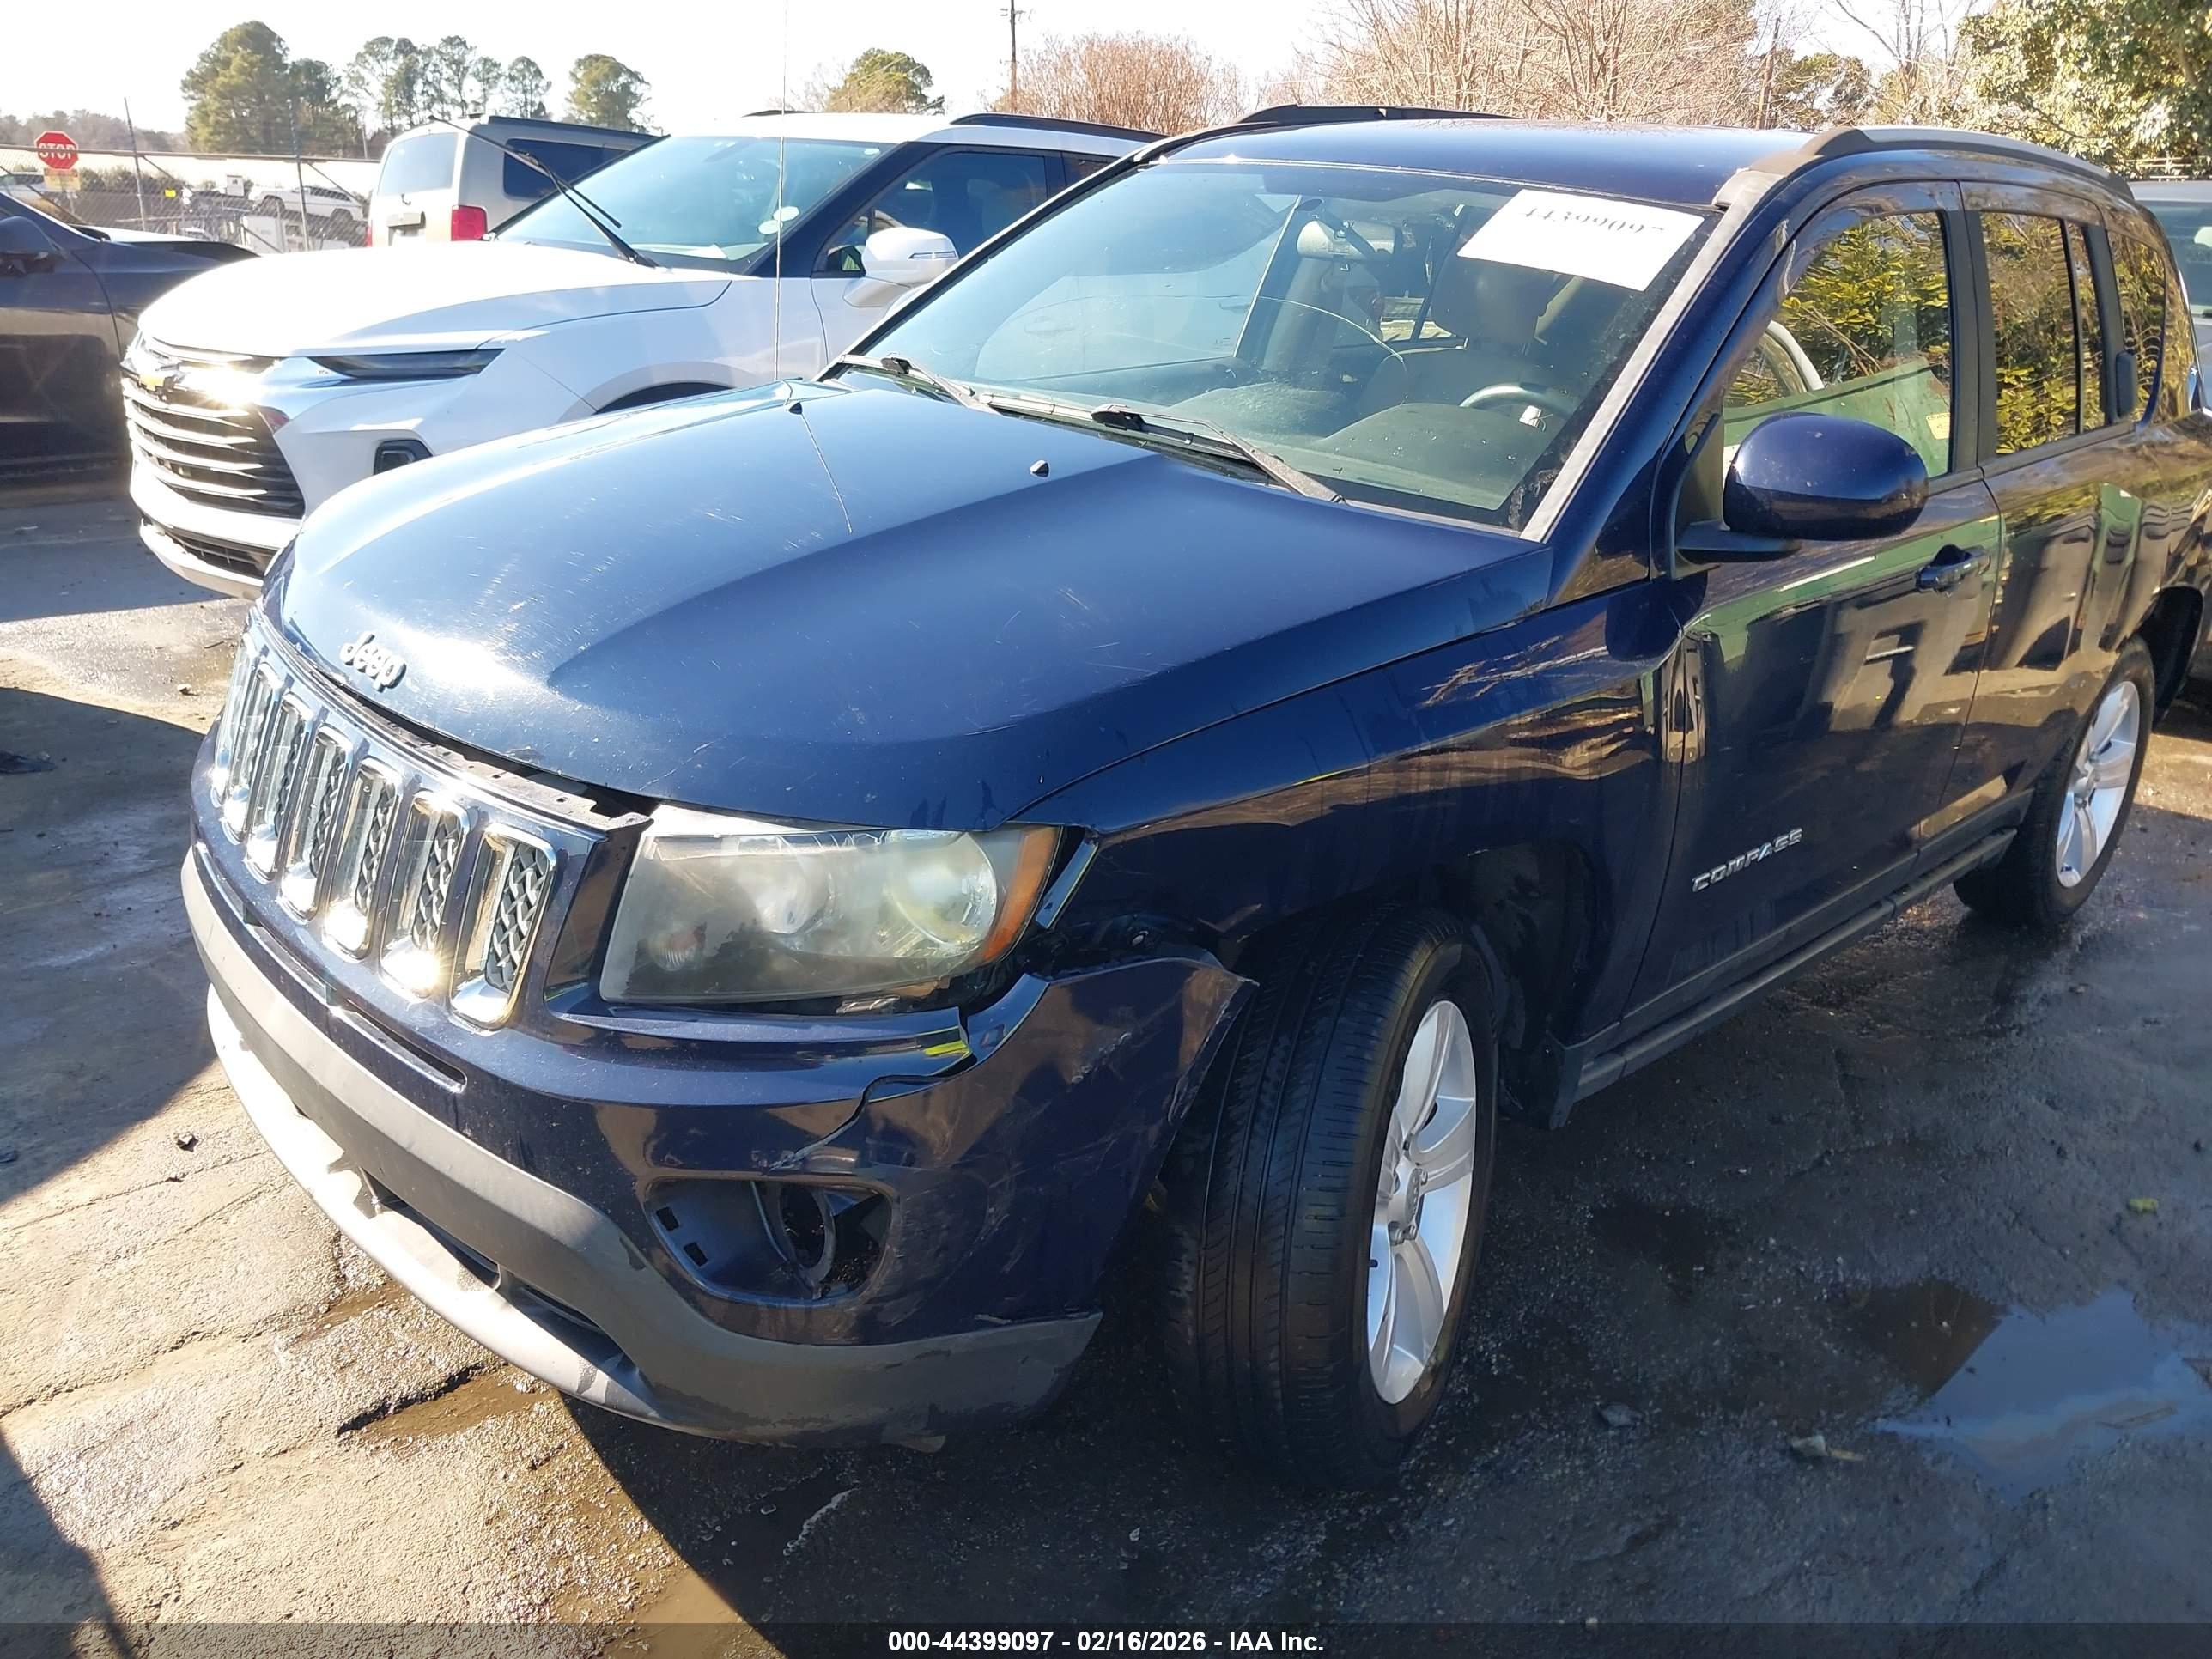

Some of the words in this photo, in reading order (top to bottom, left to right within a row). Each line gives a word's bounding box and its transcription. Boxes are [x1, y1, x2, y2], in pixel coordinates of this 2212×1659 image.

[39, 143, 76, 160] STOP
[339, 631, 407, 693] Jeep
[1692, 827, 1802, 893] COMPASS
